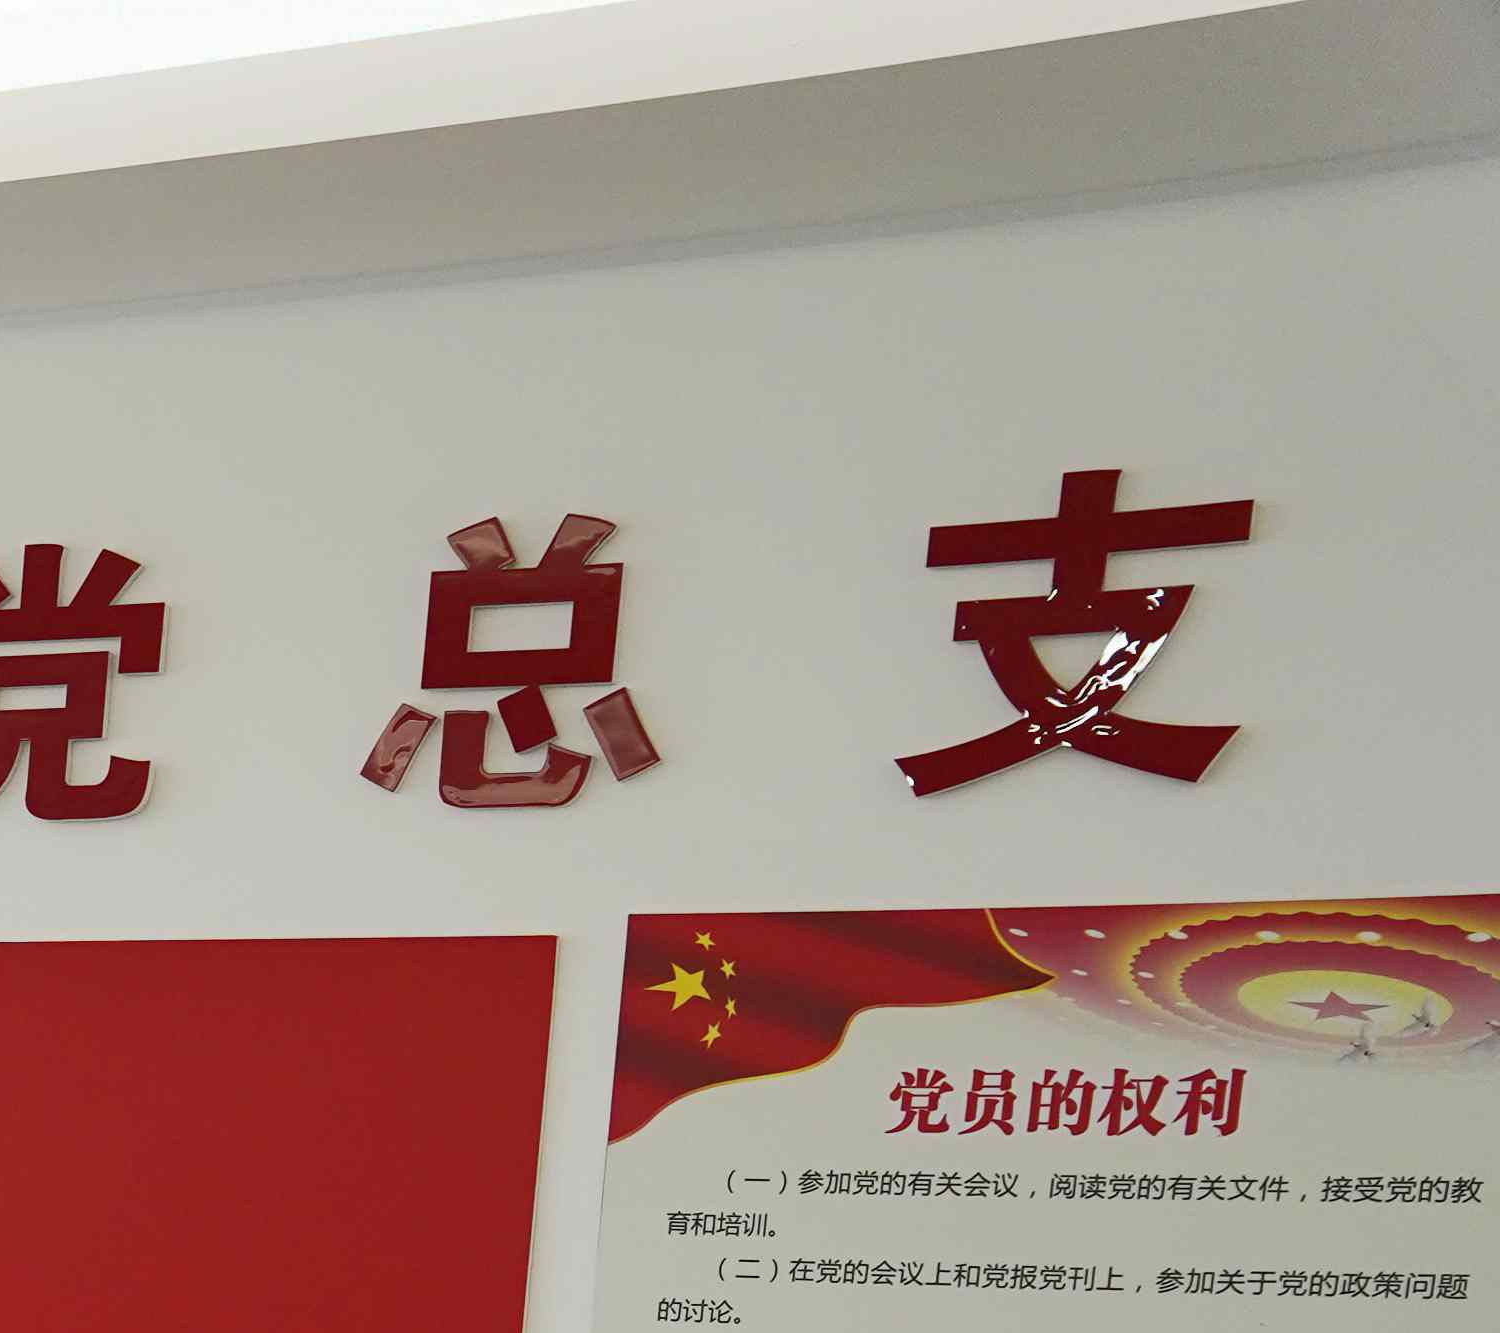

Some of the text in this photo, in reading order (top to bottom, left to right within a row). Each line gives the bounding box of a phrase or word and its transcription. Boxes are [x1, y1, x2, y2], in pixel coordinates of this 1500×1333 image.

[884, 1066, 1249, 1138] 党员的权利
[724, 1169, 1484, 1204] （一）参加党的有关会议，阅读党的有关文件，接受党的教
[664, 1211, 778, 1238] 育和培训。
[715, 1256, 1471, 1300] （二）在党的会议上和党报党刊上，参加关于党的政策问题
[655, 1297, 744, 1325] 的讨论。
